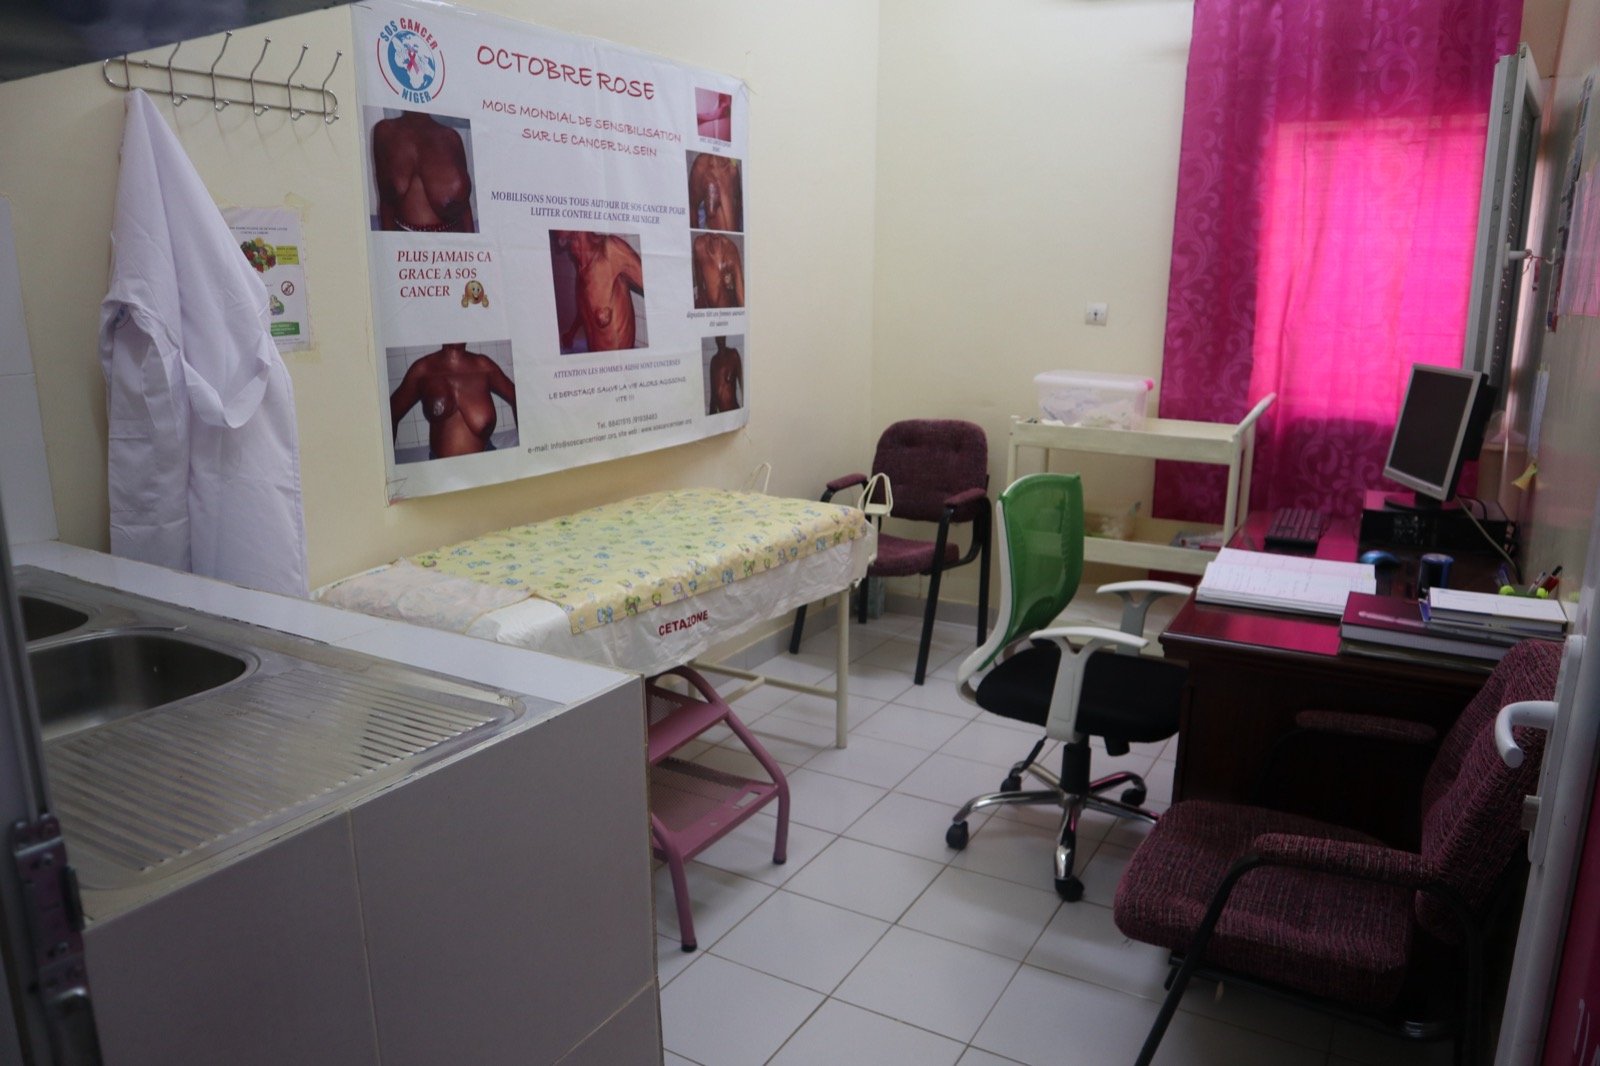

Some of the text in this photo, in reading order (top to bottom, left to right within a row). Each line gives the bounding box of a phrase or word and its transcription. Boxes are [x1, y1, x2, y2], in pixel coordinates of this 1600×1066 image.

[380, 17, 438, 50] SOS CANCER
[477, 45, 655, 100] OCTOBRE ROSE
[402, 88, 432, 104] NIGER
[482, 99, 517, 115] MOIS
[520, 107, 577, 125] MONDIAL
[578, 115, 592, 127] DE
[594, 119, 682, 143] SENSIBILISATION
[522, 128, 657, 157] SUR LE CANCER DU SEIN
[491, 191, 545, 204] MOBILISONS
[545, 195, 568, 205] NOUS
[569, 197, 590, 207] TOUS
[591, 199, 620, 210] AUTOUR
[621, 201, 629, 211] DE
[642, 204, 668, 214] CANCER
[668, 206, 686, 216] POUR
[530, 206, 660, 225] LUTTER CONTRE LE CANCER AU NIGER
[397, 251, 492, 264] PLUS JAMAIS CA
[398, 267, 477, 280] GRACE A SOS
[400, 285, 450, 298] CANCER
[553, 367, 588, 379] ATTENTION
[548, 391, 558, 400] LE
[658, 610, 709, 636] CETAZONE
